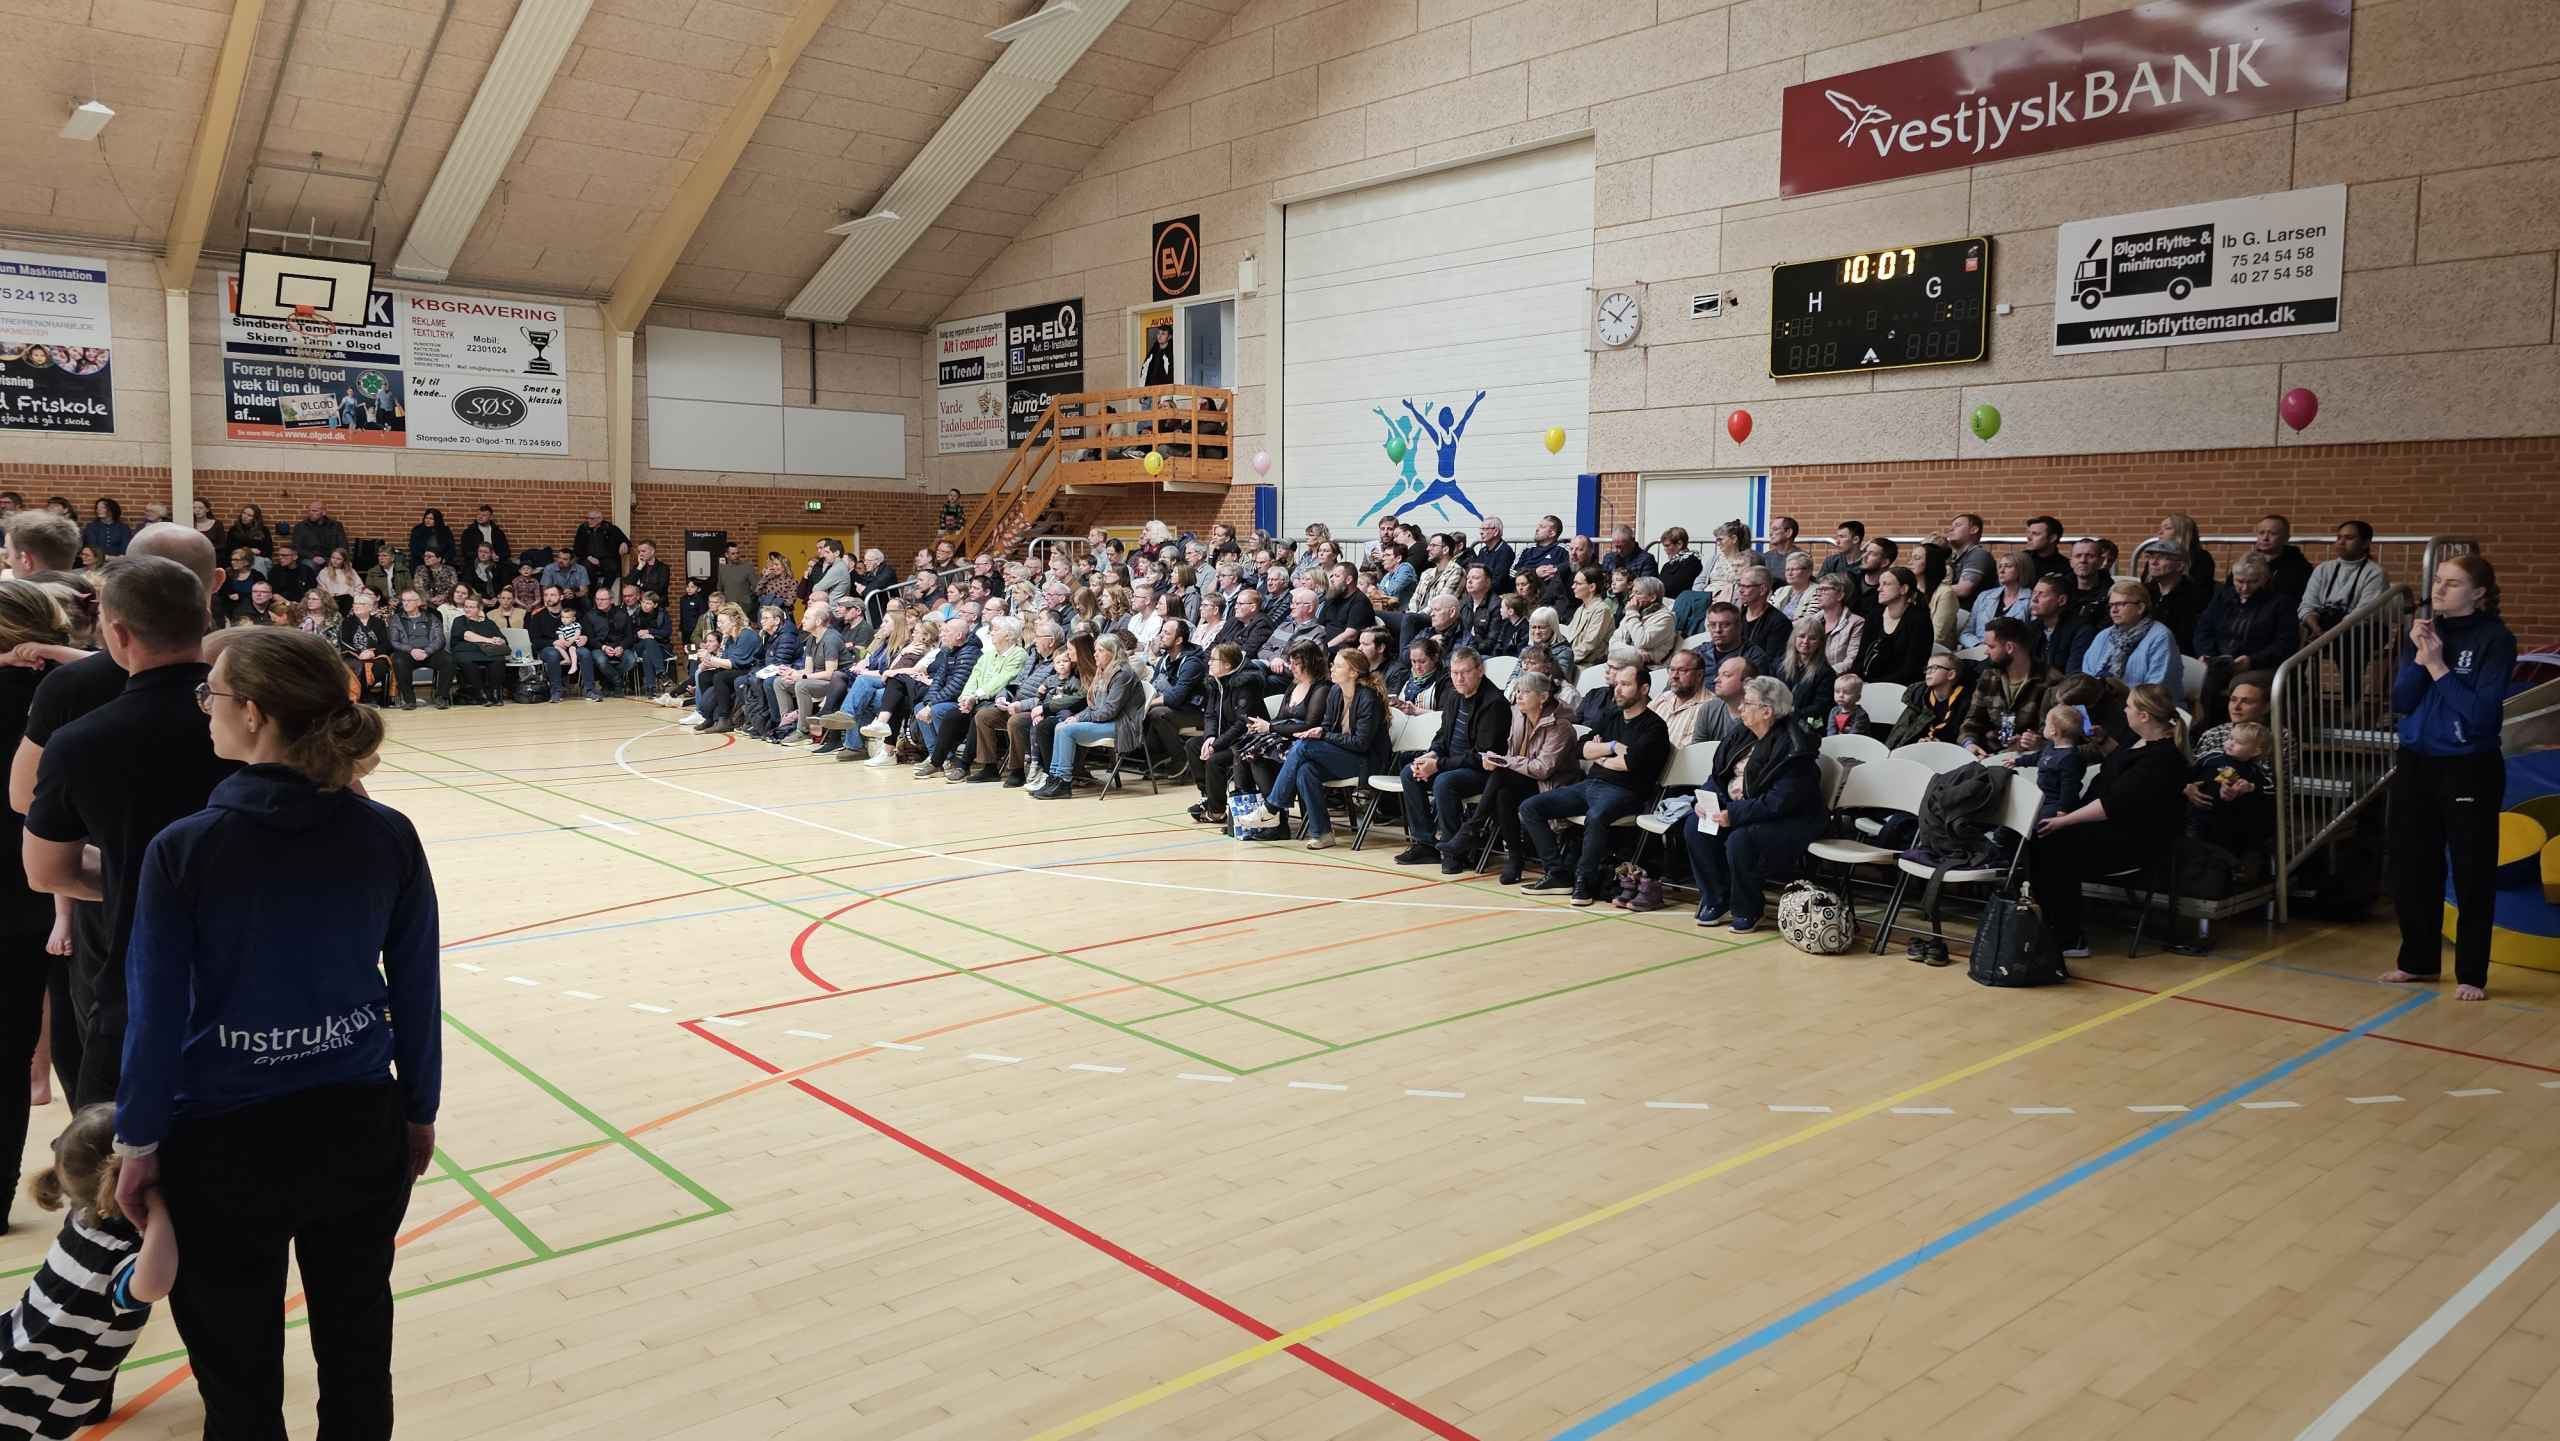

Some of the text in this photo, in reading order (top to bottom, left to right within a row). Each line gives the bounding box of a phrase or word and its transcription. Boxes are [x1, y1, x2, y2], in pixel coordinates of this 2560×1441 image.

[2113, 231, 2213, 257] Ølgod Flytte- &
[2222, 225, 2327, 249] Ib G. Larsen
[1843, 249, 1916, 284] 10:07
[2118, 252, 2207, 274] minitransport
[2231, 247, 2314, 267] 75 24 54 58
[19, 265, 93, 280] Maskinstation
[2230, 265, 2313, 285] 40 27 54 58
[0, 288, 78, 304] 5 24 12 33
[1925, 276, 1942, 298] G
[411, 298, 557, 322] KBGRAVERING
[1808, 291, 1822, 313] H
[411, 316, 447, 328] REKLAME
[2089, 306, 2296, 340] www.ibflyttemand.dk
[247, 332, 288, 344] Skjern
[346, 338, 381, 351] Ølgod
[466, 344, 507, 354] 22301024
[959, 333, 998, 352] computer!
[1012, 351, 1023, 364] EL
[232, 362, 346, 382] Forær hele Ølgod
[233, 379, 320, 394] væk til en du
[428, 378, 440, 386] til
[523, 384, 561, 396] Smart og
[233, 393, 277, 407] holder
[413, 389, 447, 398] hende...
[528, 396, 563, 406] klassisk
[17, 395, 108, 415] Friskole
[234, 408, 260, 421] af...
[466, 396, 514, 416] SØS
[940, 400, 962, 414] Varde
[1011, 399, 1038, 415] AUTO
[64, 417, 91, 426] skole
[416, 434, 458, 443] Storegade
[476, 437, 500, 446] Ølgod
[218, 1003, 377, 1052] Instruktør
[253, 1034, 354, 1066] Gymnastik
